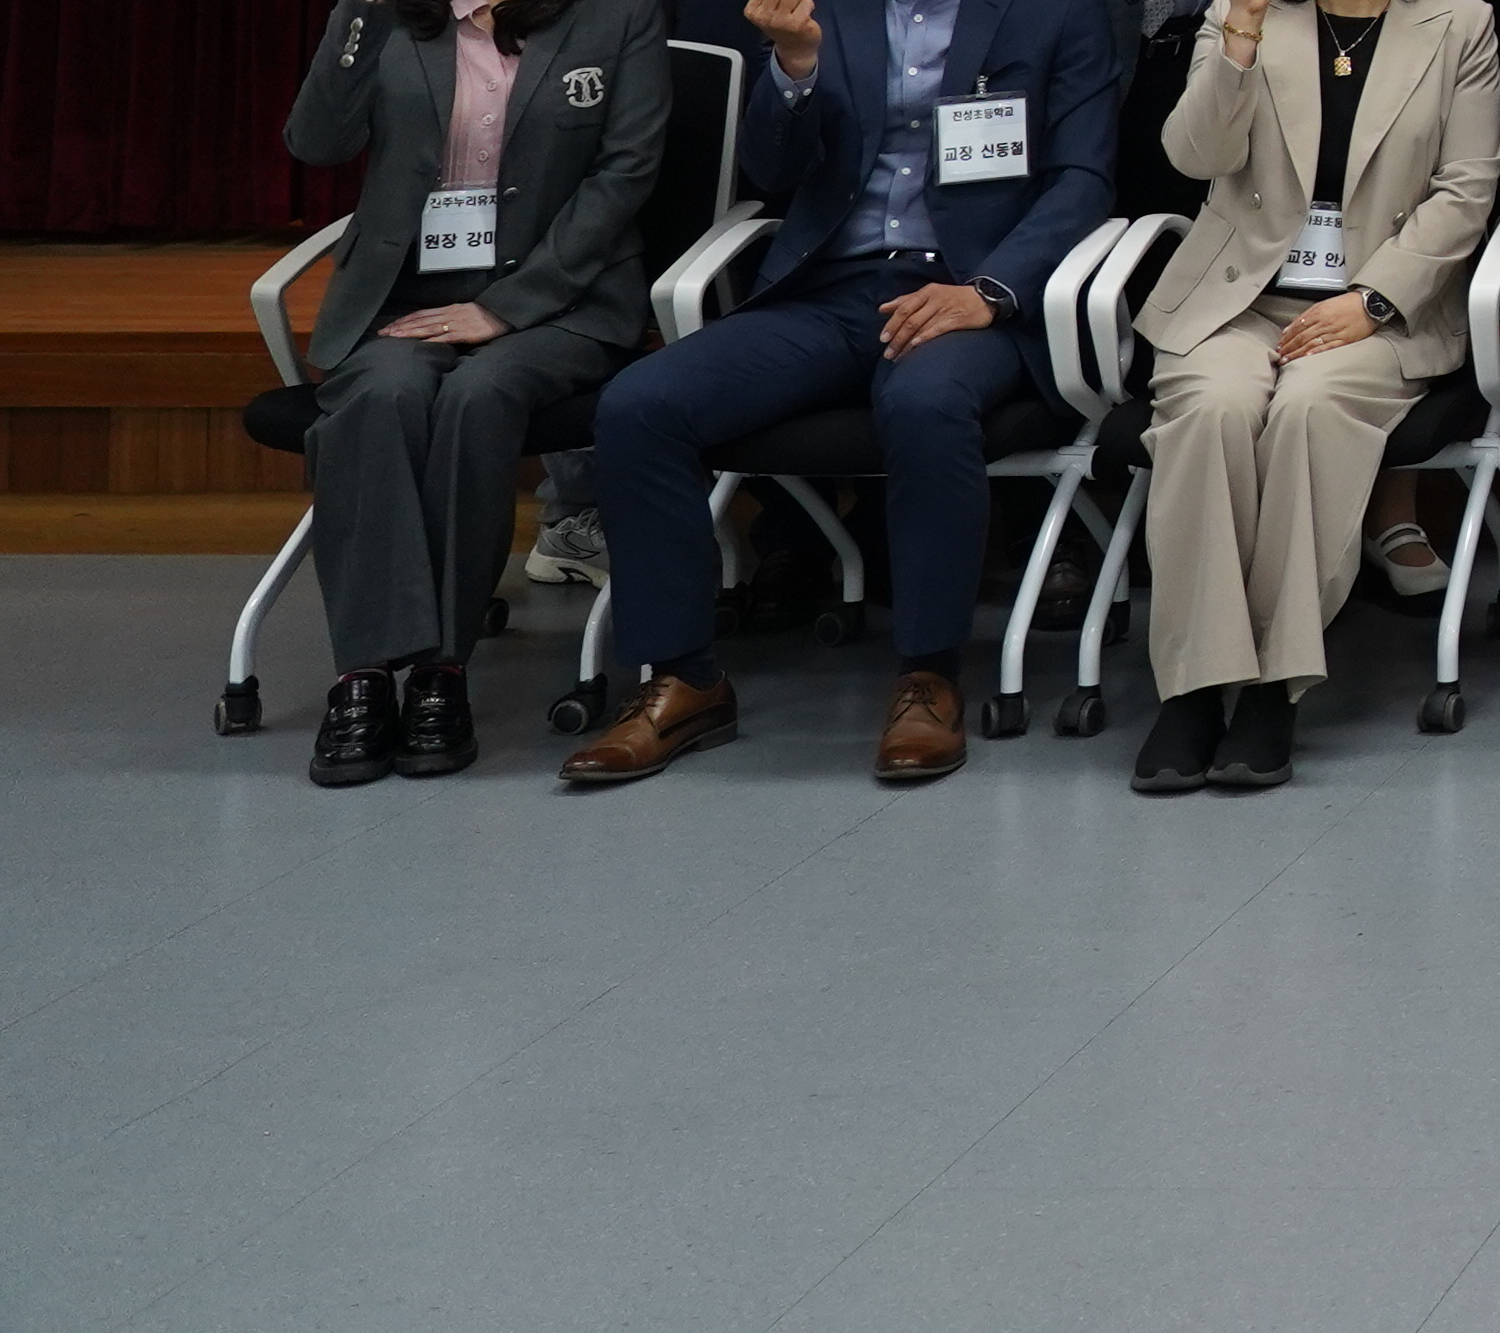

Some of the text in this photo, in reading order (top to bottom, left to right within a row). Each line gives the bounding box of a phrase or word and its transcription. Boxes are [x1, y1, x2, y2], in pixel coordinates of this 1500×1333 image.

[953, 107, 1013, 121] 진성초등학교
[945, 141, 1023, 161] 교장 신동철
[425, 234, 457, 249] 원장
[1286, 249, 1317, 267] 교장
